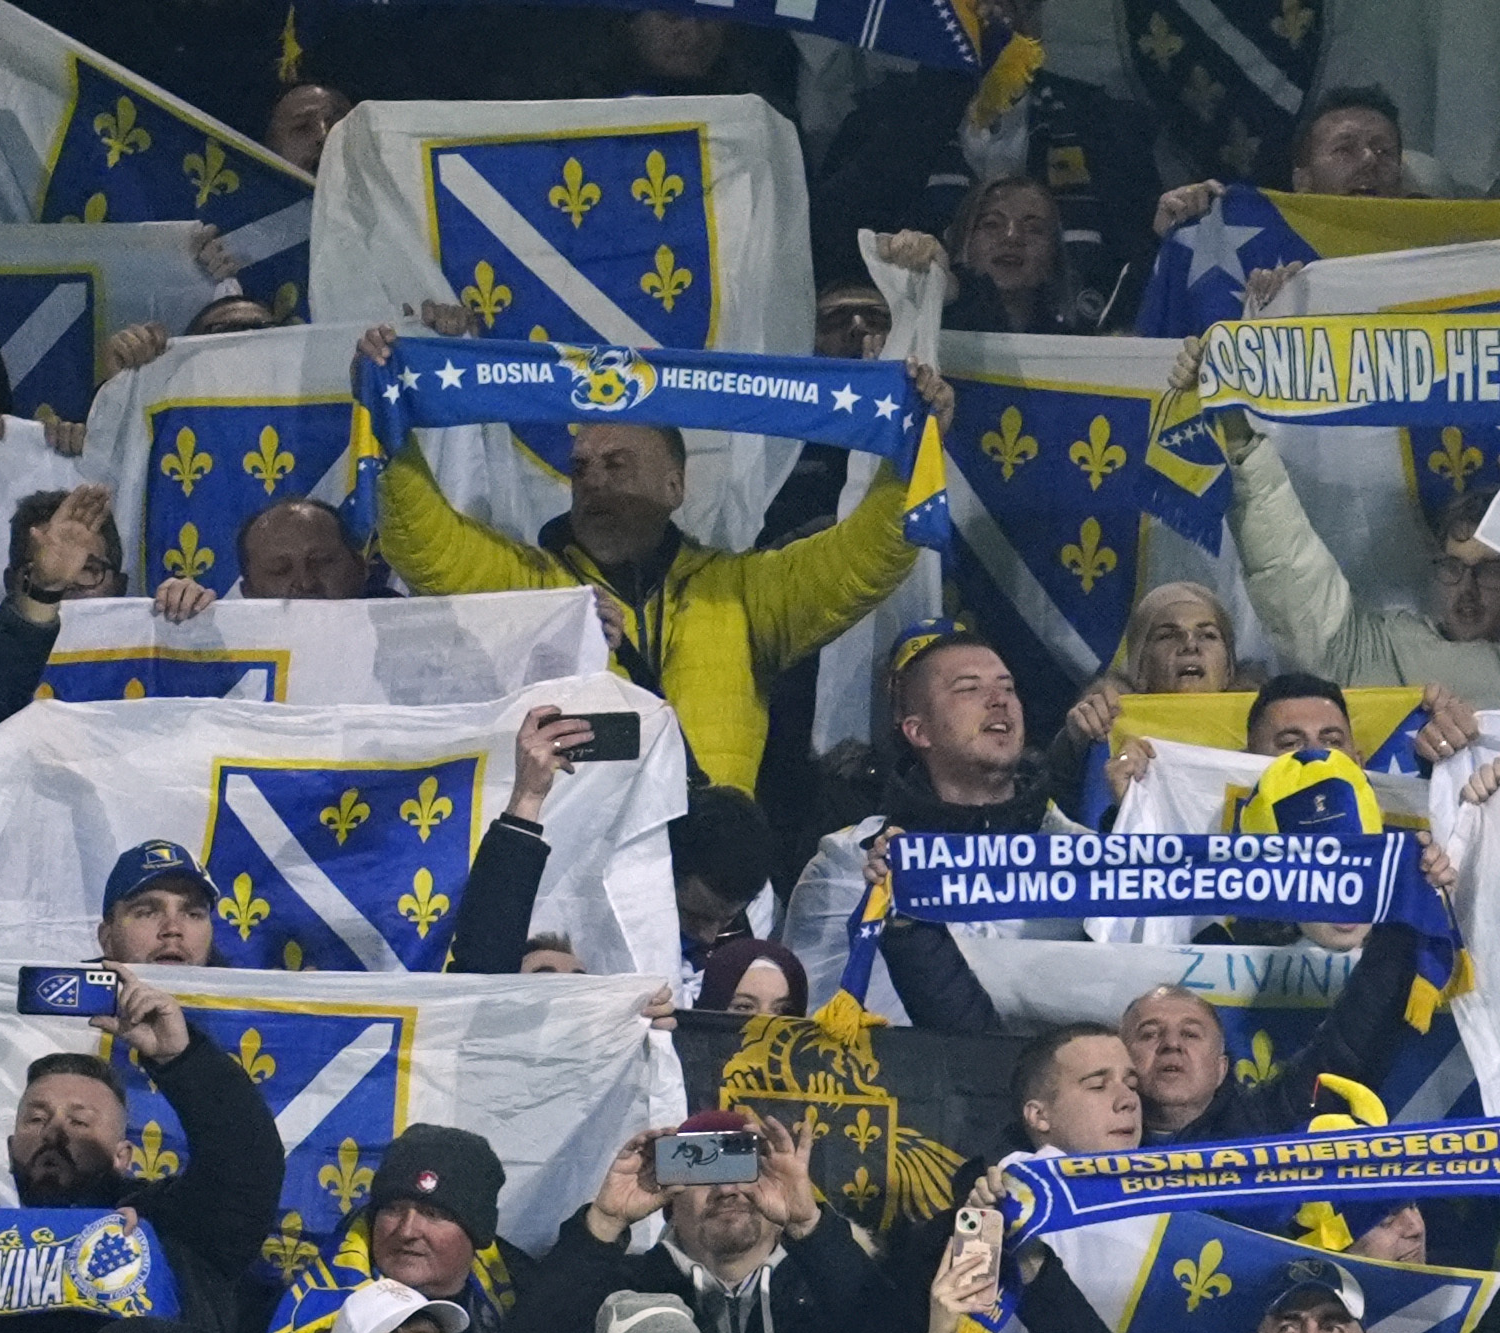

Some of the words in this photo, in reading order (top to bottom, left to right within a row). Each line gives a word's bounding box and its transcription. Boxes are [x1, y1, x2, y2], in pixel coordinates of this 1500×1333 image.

[476, 361, 555, 386] BOSNA
[1200, 324, 1337, 402] BOSNIA
[1349, 329, 1436, 402] AND
[661, 367, 820, 404] HERCEGOVINA
[900, 834, 1035, 873] HAJMO
[1048, 832, 1196, 870] BOSNO,
[1207, 834, 1373, 870] BOSNO...
[910, 870, 1080, 906] ...HAJMO
[1089, 867, 1365, 906] HERCEGOVINO
[1058, 1144, 1242, 1180] BOSNA
[1120, 1166, 1240, 1193] BOSNIA
[1256, 1162, 1325, 1186] AND
